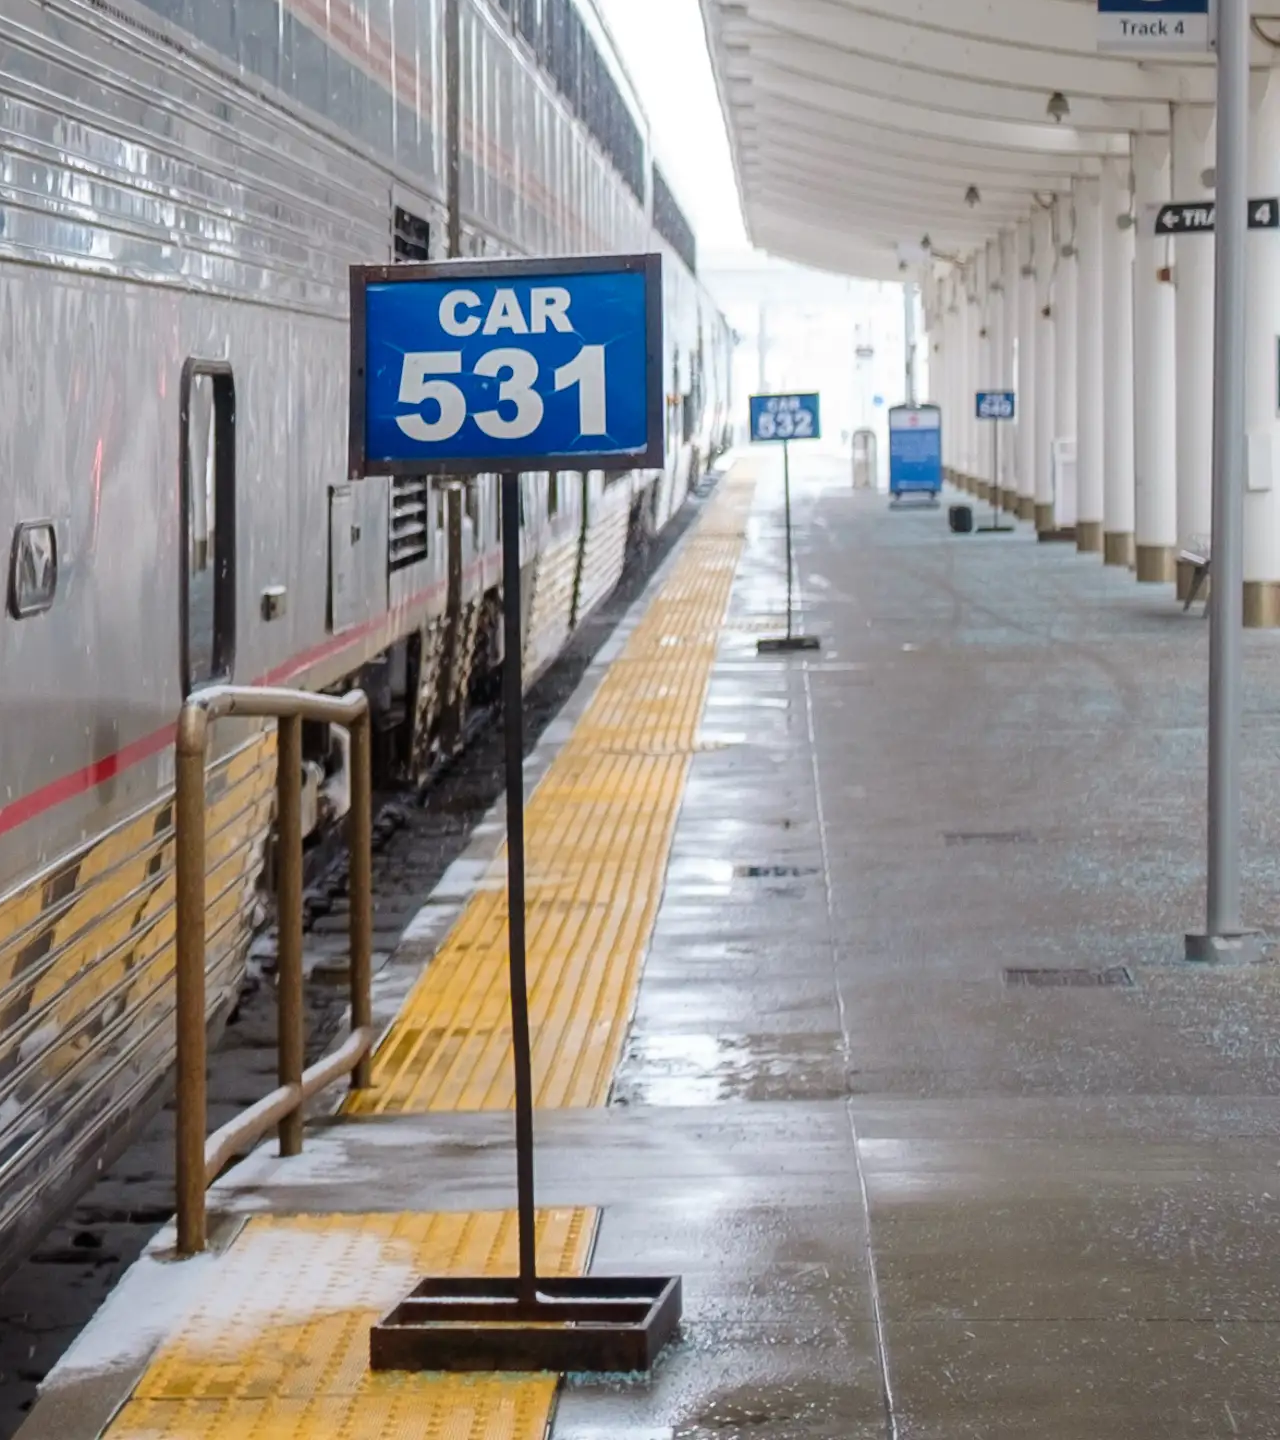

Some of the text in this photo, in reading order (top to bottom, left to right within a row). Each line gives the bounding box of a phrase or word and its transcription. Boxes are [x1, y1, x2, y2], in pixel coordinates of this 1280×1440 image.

[1119, 18, 1185, 37] Track 4
[1183, 203, 1271, 227] TRA 4
[438, 286, 575, 337] CAR
[394, 344, 607, 442] 531
[758, 409, 814, 437] 532
